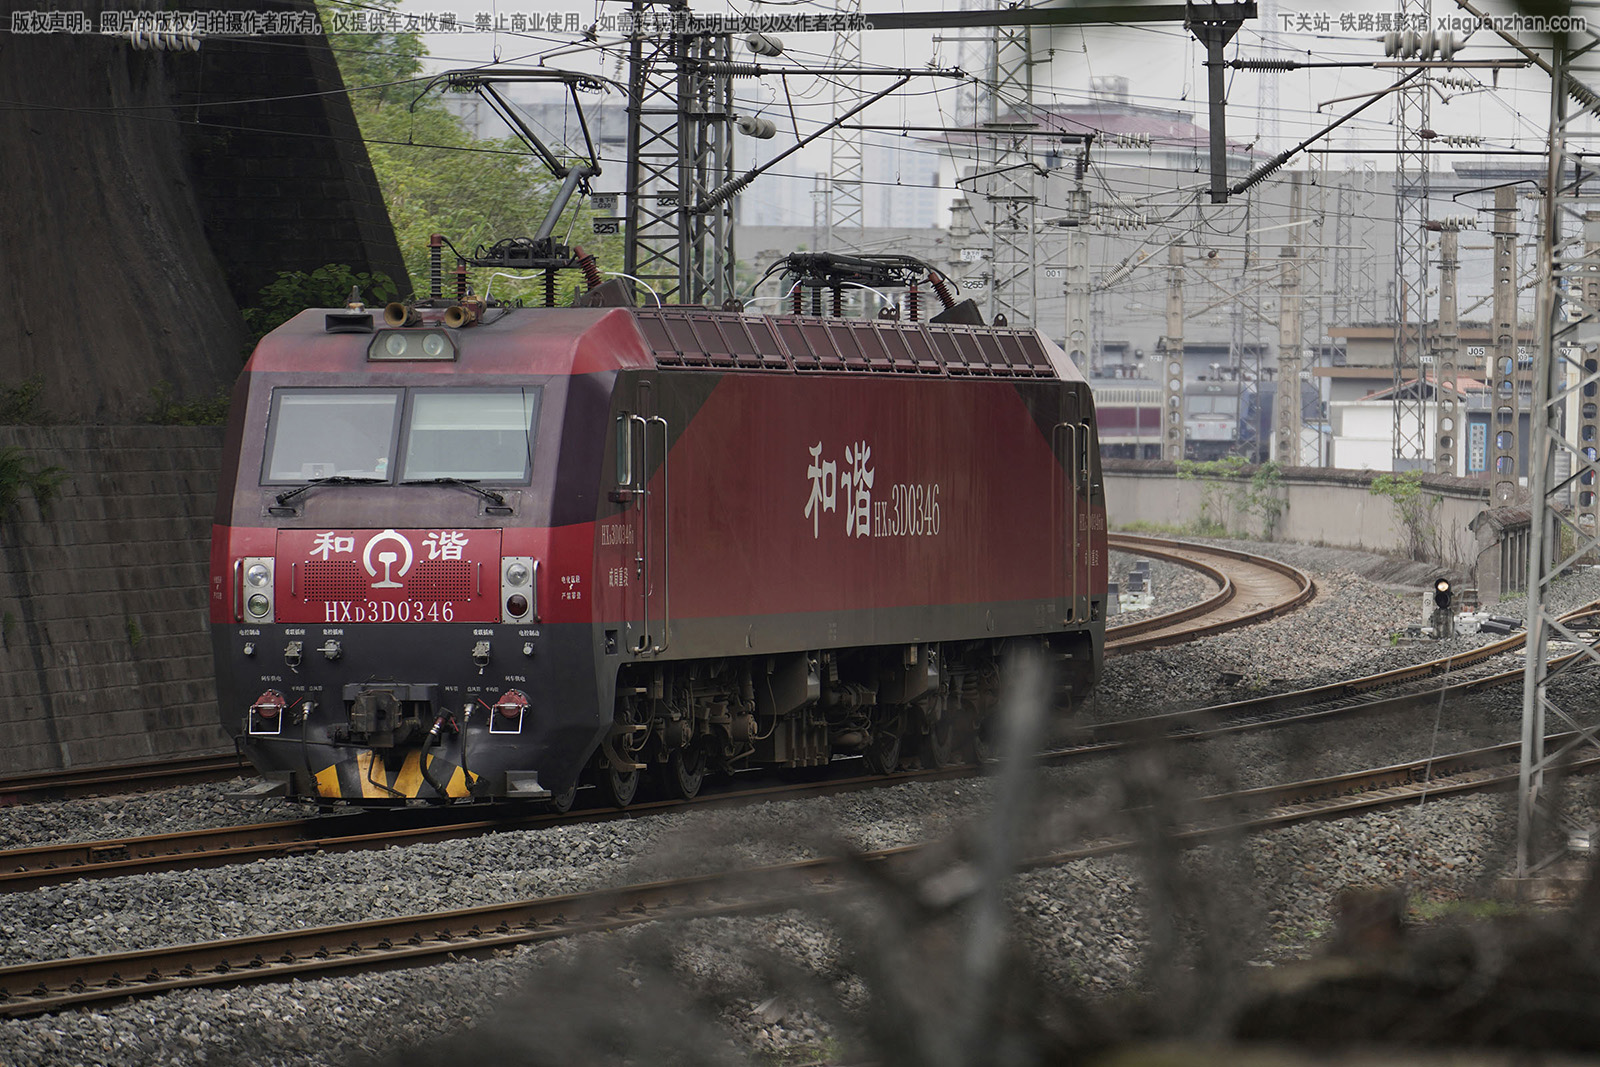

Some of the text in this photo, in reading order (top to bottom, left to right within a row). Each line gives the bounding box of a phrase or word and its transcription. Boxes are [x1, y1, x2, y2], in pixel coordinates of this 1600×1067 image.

[593, 223, 619, 234] 3251
[963, 281, 983, 289] 3255
[804, 440, 875, 539] 和谐
[309, 531, 469, 561] 和 谐
[325, 601, 454, 622] HXD3D0346
